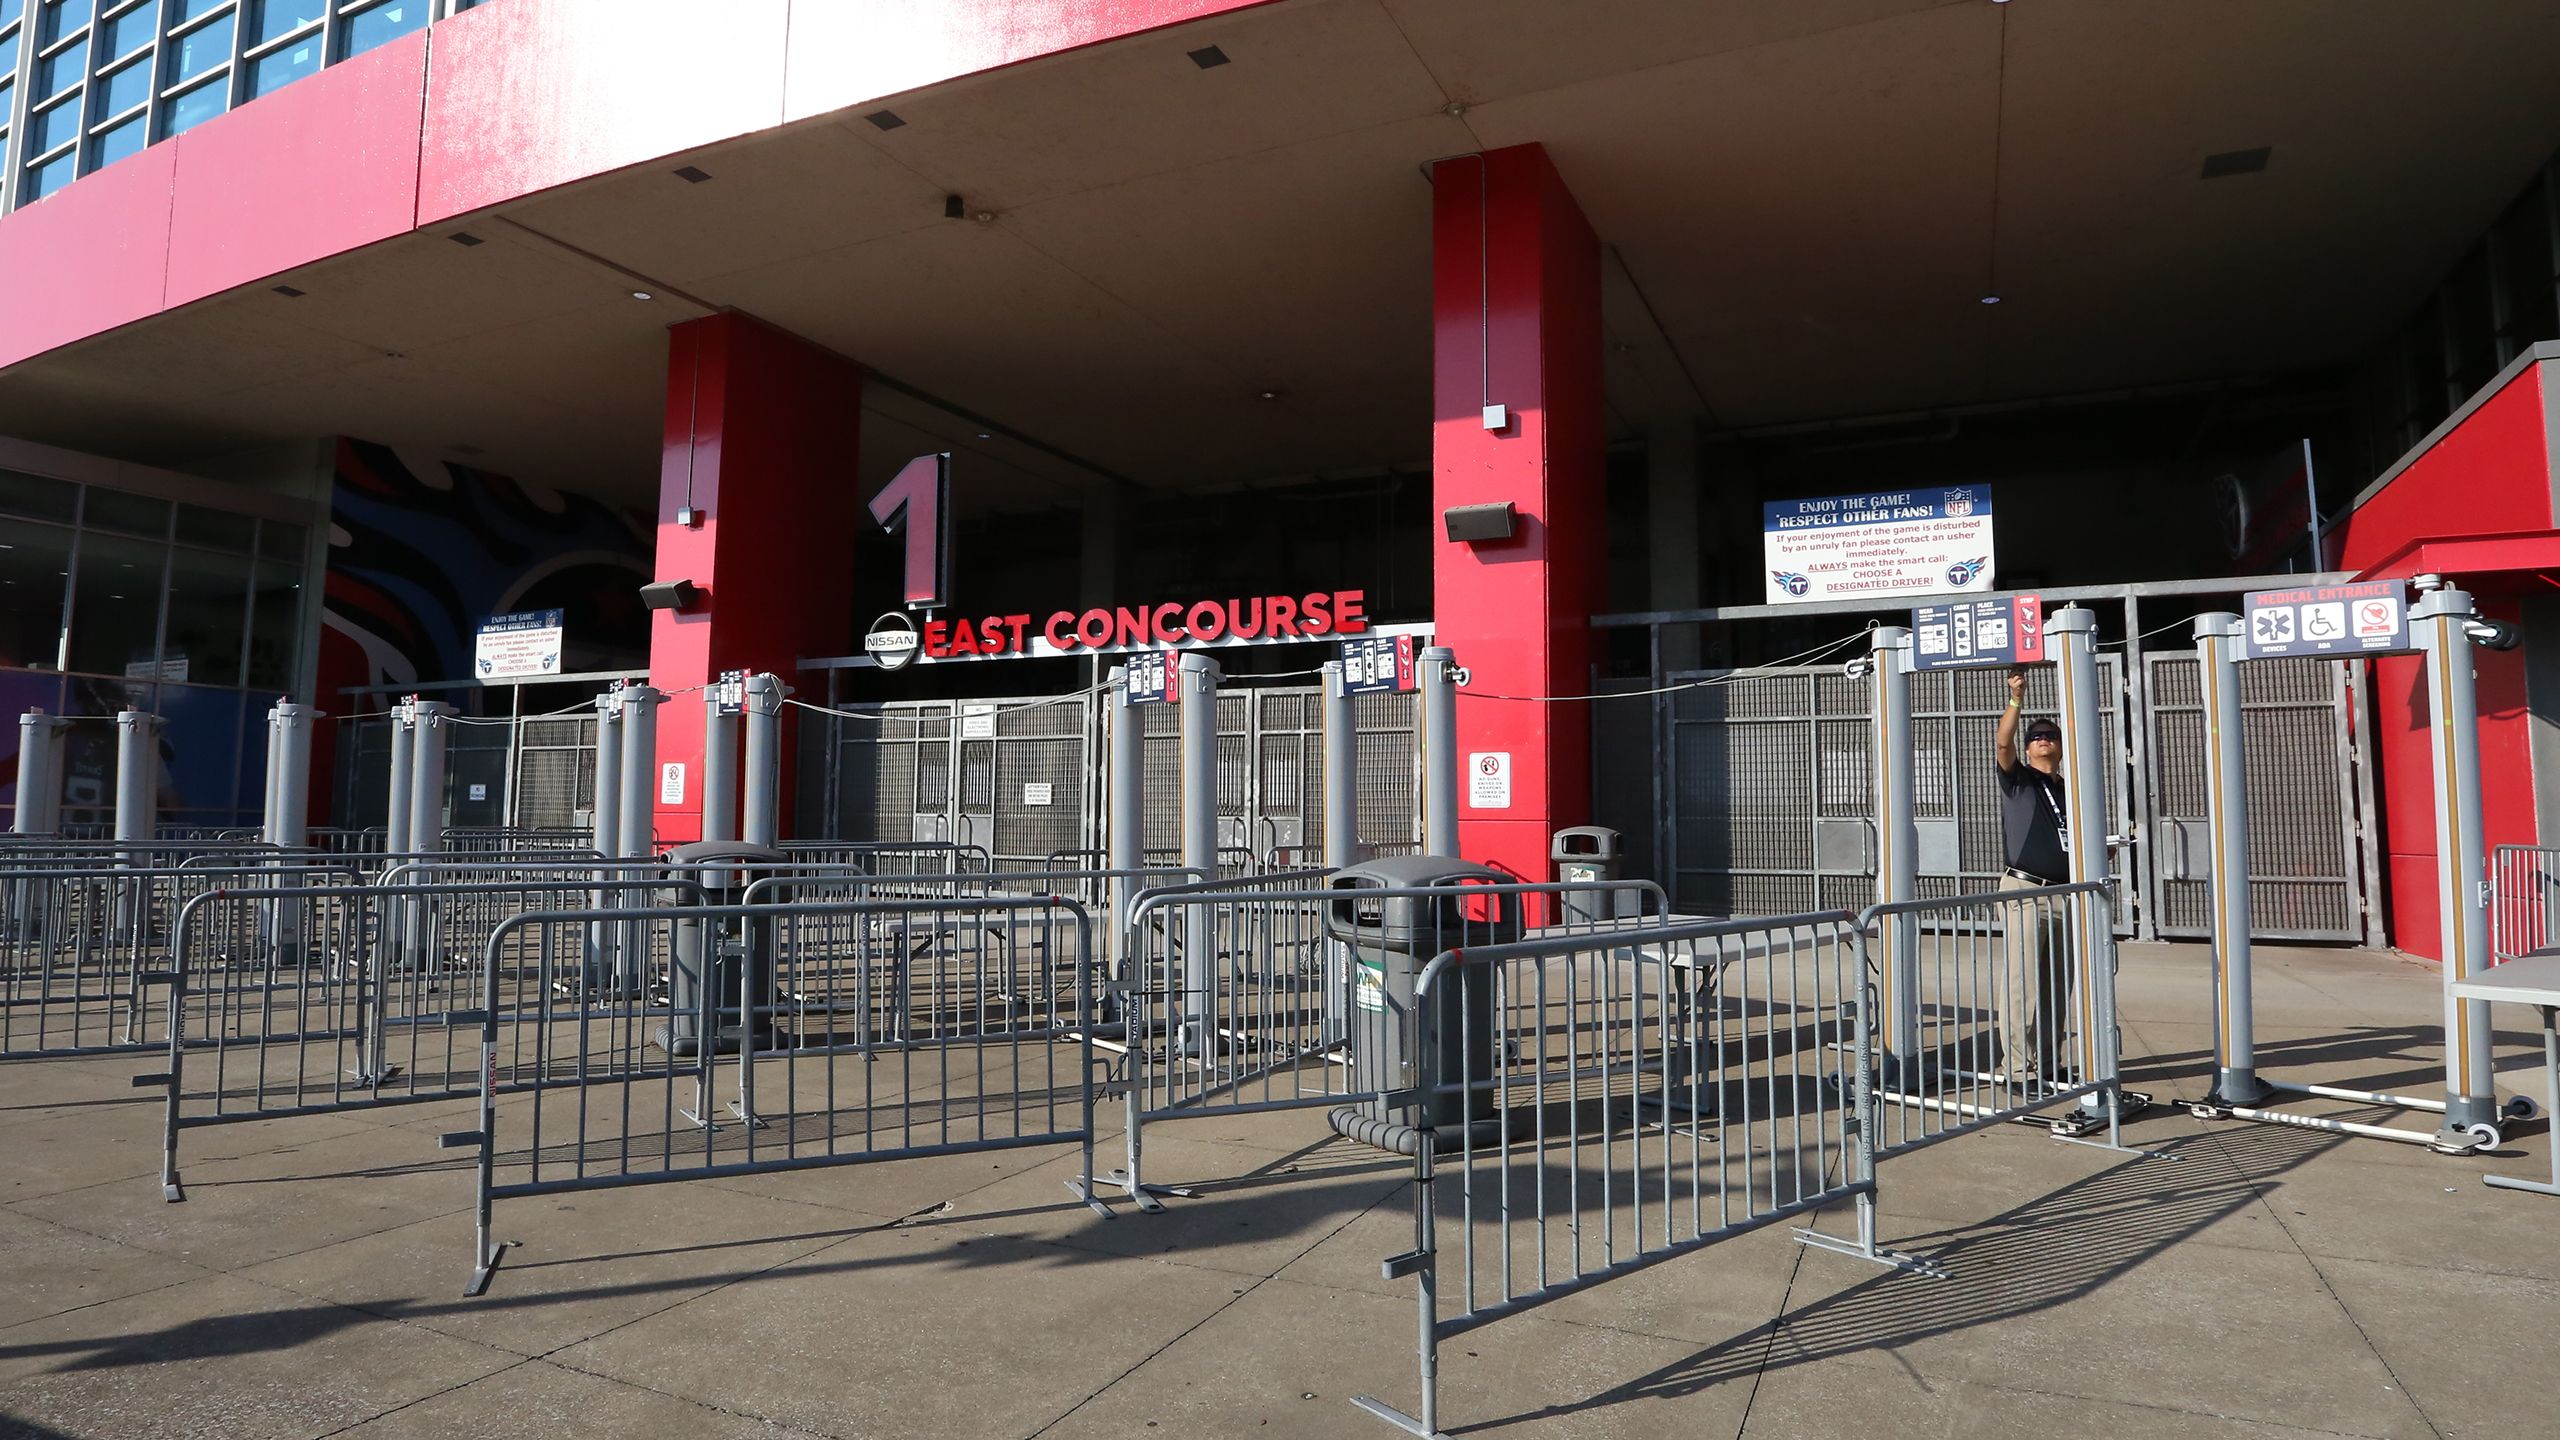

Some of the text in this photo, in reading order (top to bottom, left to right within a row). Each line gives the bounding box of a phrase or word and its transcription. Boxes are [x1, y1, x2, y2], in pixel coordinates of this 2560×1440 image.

[1799, 494, 1911, 513] ENJOY THE GAME!
[1948, 501, 1969, 514] NFL
[1779, 505, 1933, 528] RESPECT OTHER FANS!
[867, 452, 947, 606] 1
[1776, 520, 1980, 543] If your enjoyment of the game is disturbed
[1782, 545, 1793, 553] by
[1810, 542, 1839, 551] unruly
[1842, 540, 1857, 548] fan
[1860, 538, 1890, 548] please
[1893, 534, 1929, 544] contact
[1947, 531, 1976, 540] usher
[1846, 547, 1908, 559] immediately.
[1808, 555, 1948, 572] ALWAYS make the smart call:
[1853, 569, 1893, 578] CHOOSE
[1826, 577, 1933, 592] DESIGNATED DRIVER!
[2256, 583, 2391, 605] MEDICAL ENTRANCE
[924, 589, 1368, 658] EAST CONCOURSE
[867, 636, 914, 647] NISSAN
[2262, 645, 2288, 653] DEVICES
[488, 1052, 497, 1098] NISSAN
